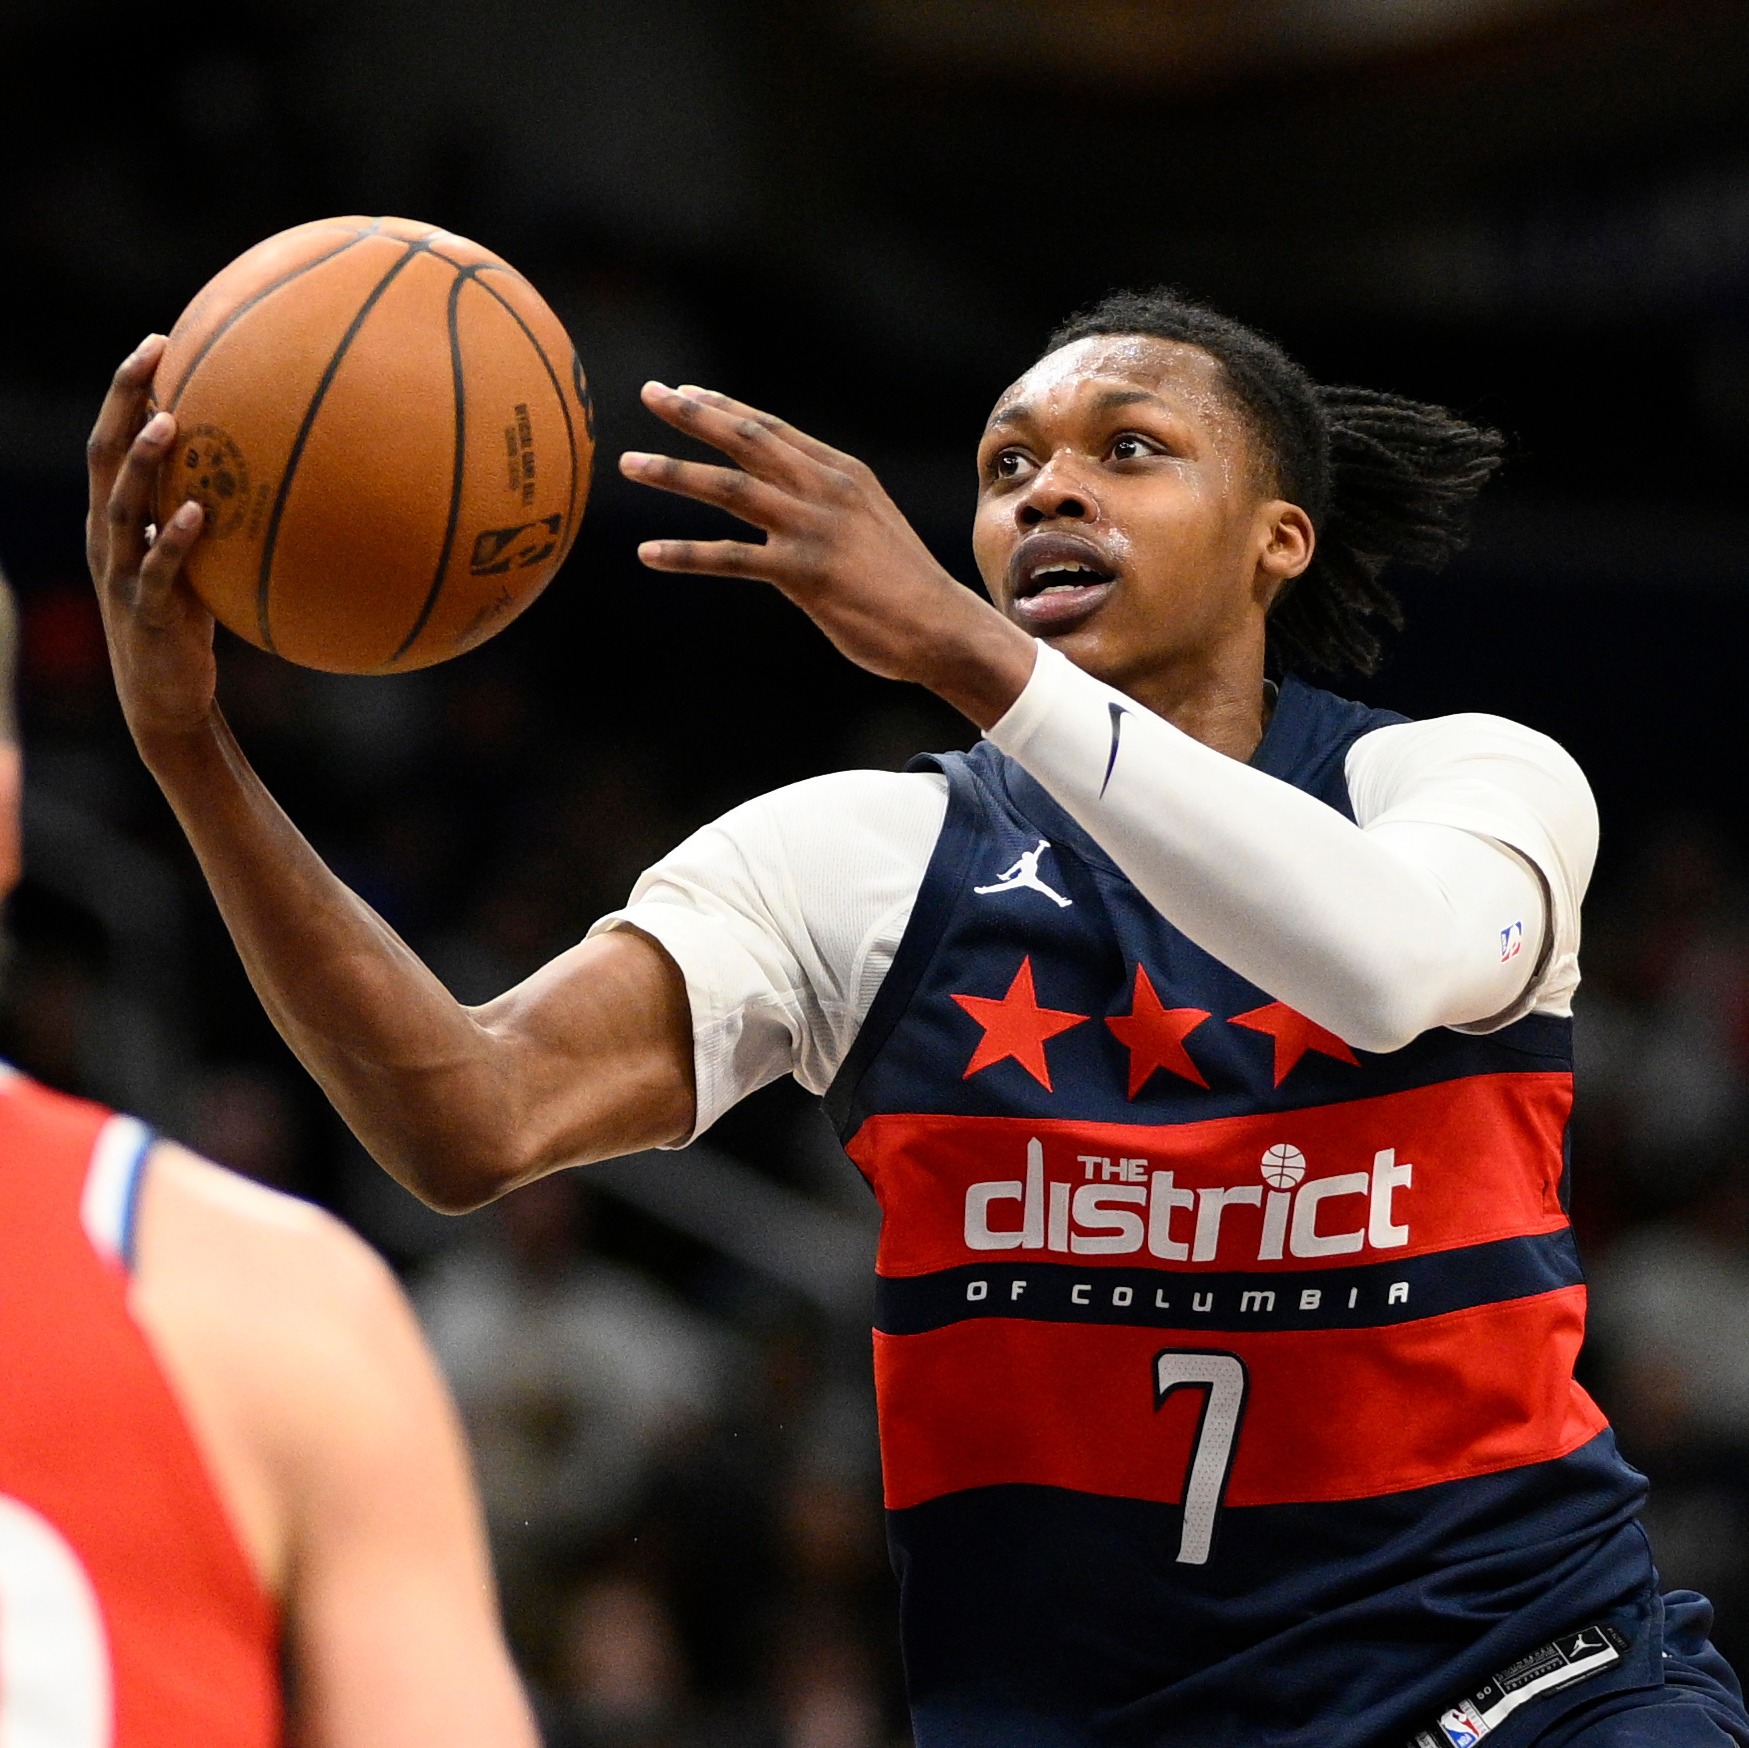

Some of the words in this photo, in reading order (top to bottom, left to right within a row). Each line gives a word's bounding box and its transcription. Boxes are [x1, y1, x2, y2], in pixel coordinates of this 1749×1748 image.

[964, 1136, 1413, 1263] district
[1077, 1155, 1149, 1182] THE
[966, 1280, 1027, 1302] OF
[1071, 1281, 1410, 1313] COLUMBIA
[1155, 1349, 1248, 1566] 7
